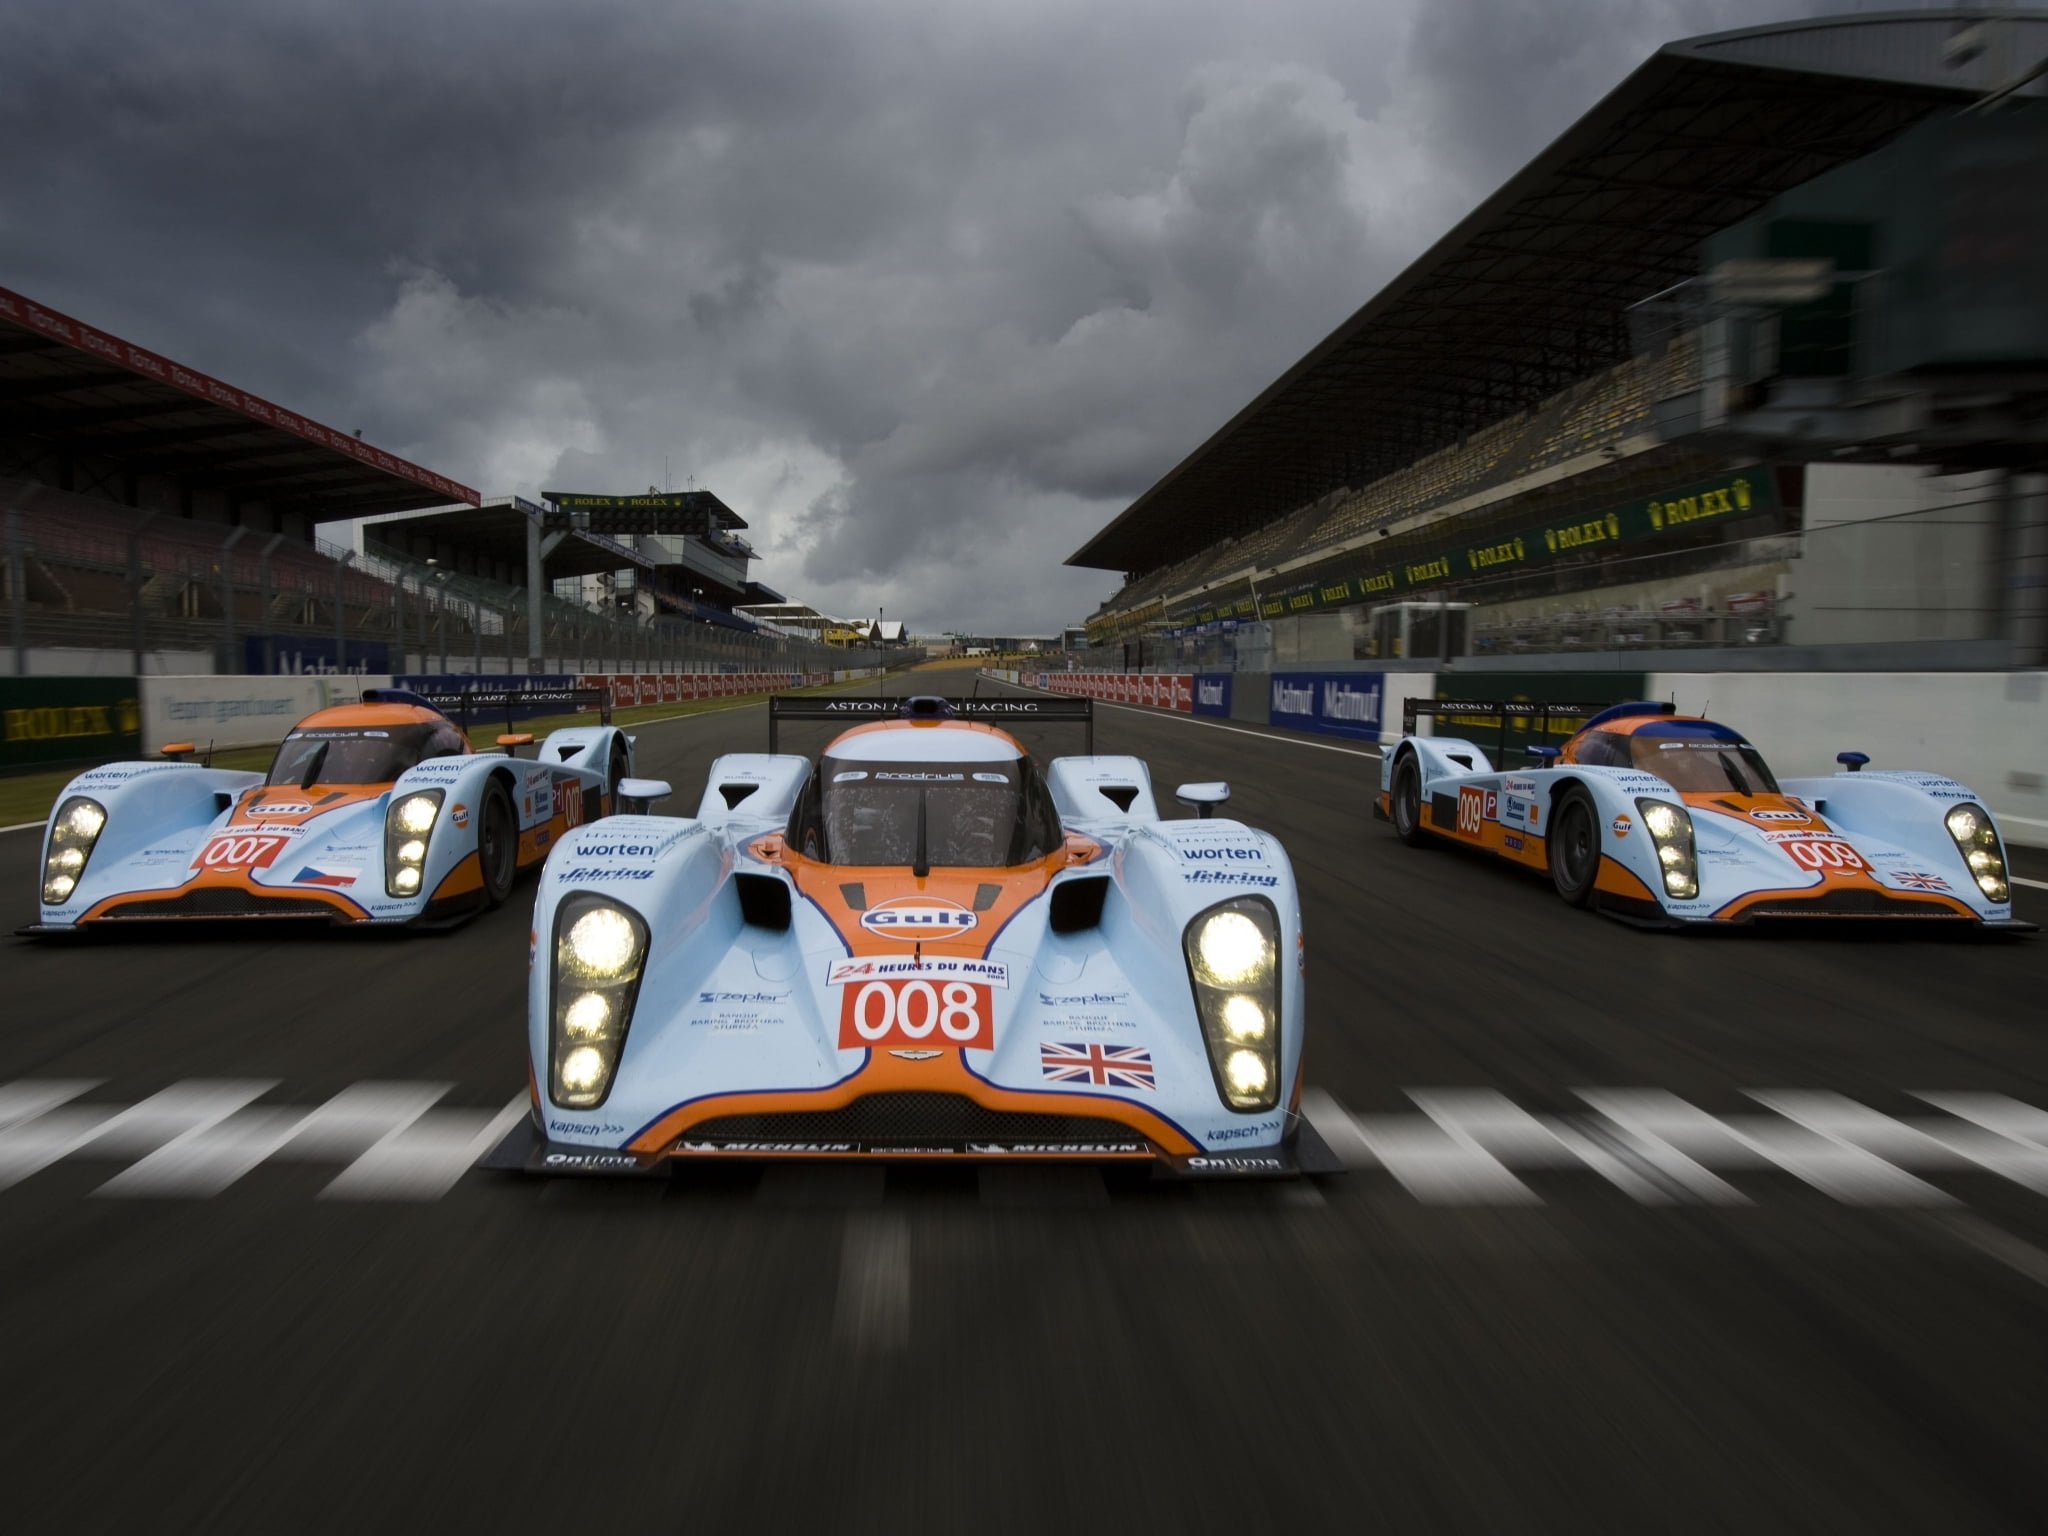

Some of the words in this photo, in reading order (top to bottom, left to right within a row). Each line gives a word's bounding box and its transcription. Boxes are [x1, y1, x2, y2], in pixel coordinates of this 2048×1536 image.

[26, 304, 73, 339] TOTAL
[80, 327, 121, 358] TOTAL
[128, 347, 165, 376] TOTAL
[170, 365, 205, 392] TOTAL
[208, 382, 239, 406] TOTAL
[244, 397, 272, 419] TOTAL
[274, 409, 301, 430] TOTAL
[302, 422, 327, 441] TOTAL
[330, 433, 352, 451] TOTAL
[354, 443, 375, 461] TOTAL
[376, 453, 396, 470] TOTAL
[399, 462, 415, 478] TOTAL
[417, 469, 433, 485] TOTAL
[435, 477, 450, 492] TOTAL
[451, 484, 466, 498] TOTAL
[467, 490, 480, 504] TOTAL
[575, 498, 611, 506] ROLEX
[631, 498, 668, 506] ROLEX
[1364, 574, 1389, 592] ROLEX
[1413, 564, 1440, 582] ROLEX
[1477, 543, 1515, 566] ROLEX
[1557, 520, 1606, 549] ROLEX
[1665, 488, 1736, 524] ROLEX
[616, 681, 634, 698] TOTAL
[641, 680, 657, 696] TOTAL
[663, 680, 677, 694] TOTAL
[1198, 679, 1223, 706] Matmut
[521, 692, 573, 701] RACING
[1271, 679, 1313, 716] Matmut
[1322, 681, 1380, 723] Matmut
[825, 702, 887, 711] ASTON
[966, 703, 1038, 712] RACING
[1440, 703, 1481, 711] ASTON
[1483, 703, 1534, 712] MRTIN
[85, 770, 129, 780] worten
[416, 764, 460, 773] worten
[1617, 775, 1659, 783] worten
[248, 805, 310, 814] Gulf
[565, 786, 580, 828] 007
[1460, 792, 1481, 833] 009
[452, 809, 469, 822] Gulf
[1752, 811, 1809, 821] Gulf
[1613, 821, 1632, 831] Gulf
[205, 836, 280, 865] 007
[576, 844, 654, 857] worten
[1183, 848, 1262, 860] worten
[1790, 841, 1863, 868] 009
[371, 903, 402, 912] kapsch
[864, 910, 975, 926] Gulf
[831, 962, 876, 980] 24
[878, 962, 933, 973] HEURES
[938, 963, 958, 971] DU
[963, 963, 1005, 975] MANS
[854, 980, 981, 1041] 008
[550, 1119, 600, 1136] kapsch
[1207, 1125, 1259, 1141] kapsch
[724, 1143, 850, 1151] MICHELIN
[1012, 1144, 1138, 1152] MICHELIN
[546, 1153, 638, 1165] Ontime
[1188, 1156, 1280, 1168] Ontime
